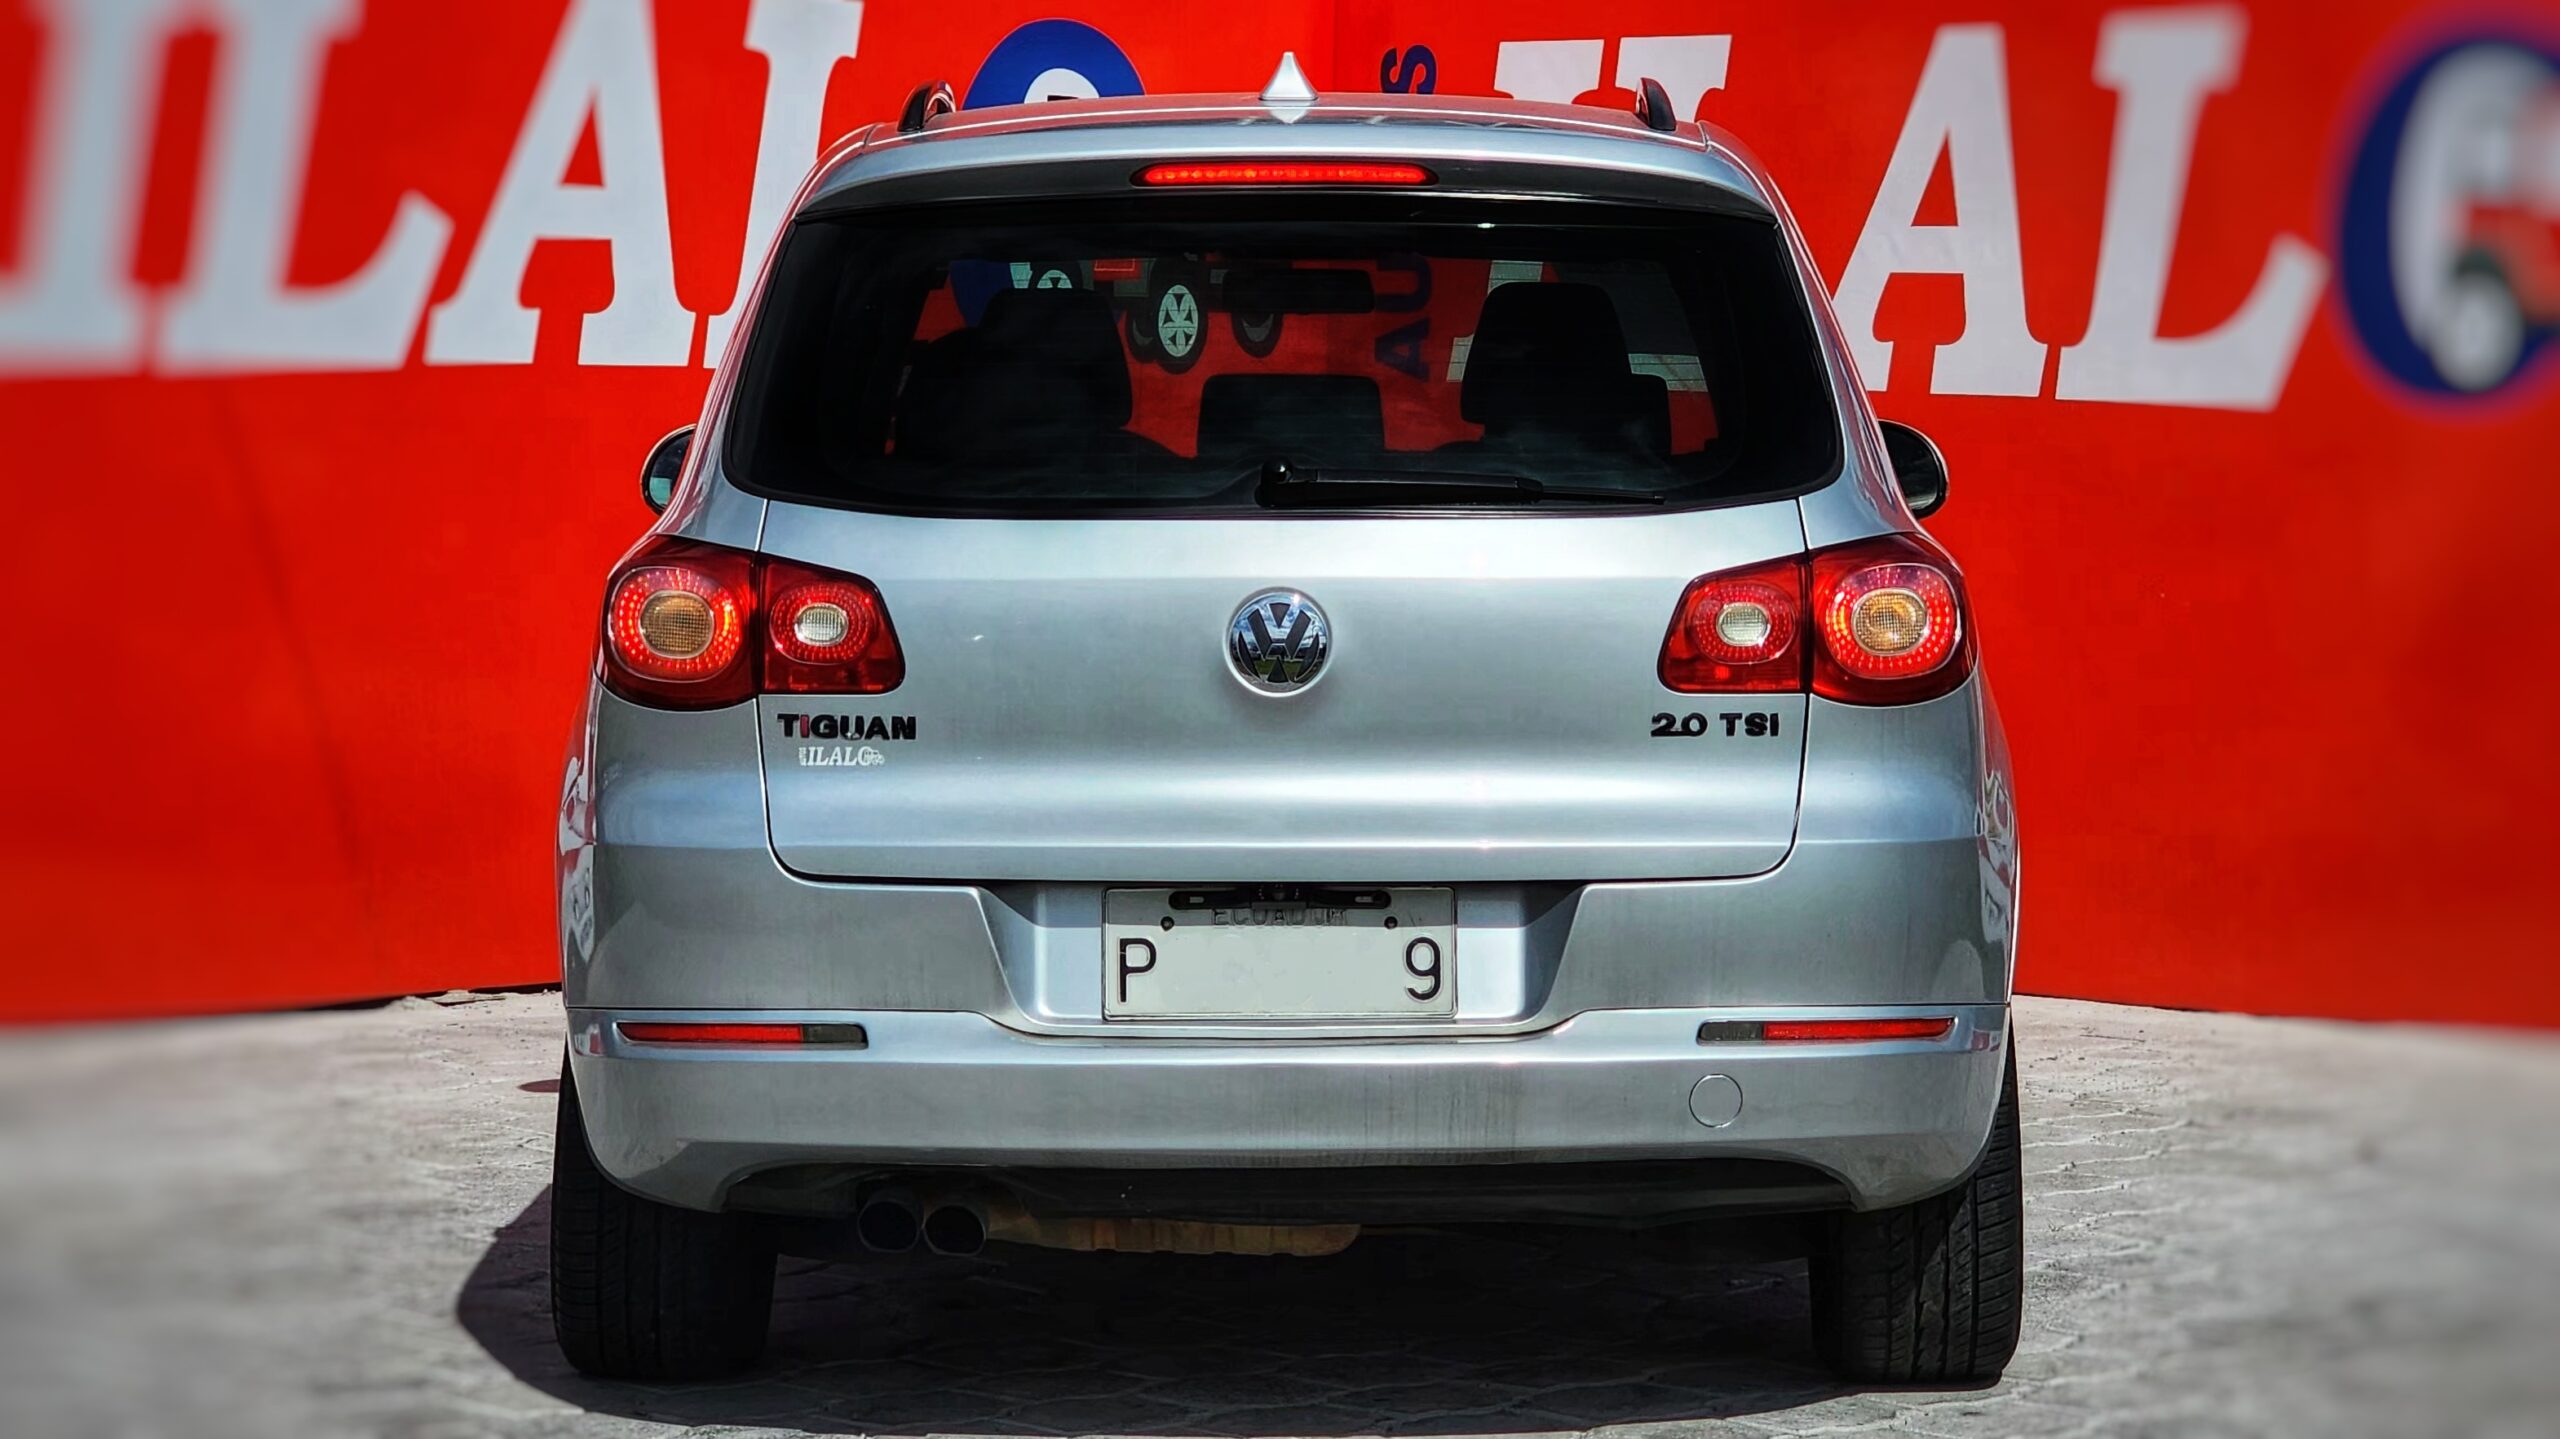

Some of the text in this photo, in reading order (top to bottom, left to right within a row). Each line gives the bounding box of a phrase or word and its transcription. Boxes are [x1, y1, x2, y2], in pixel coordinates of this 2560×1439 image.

[777, 713, 917, 740] TIGUAN
[1719, 712, 1780, 737] TSI
[1118, 936, 1442, 1003] P 9
